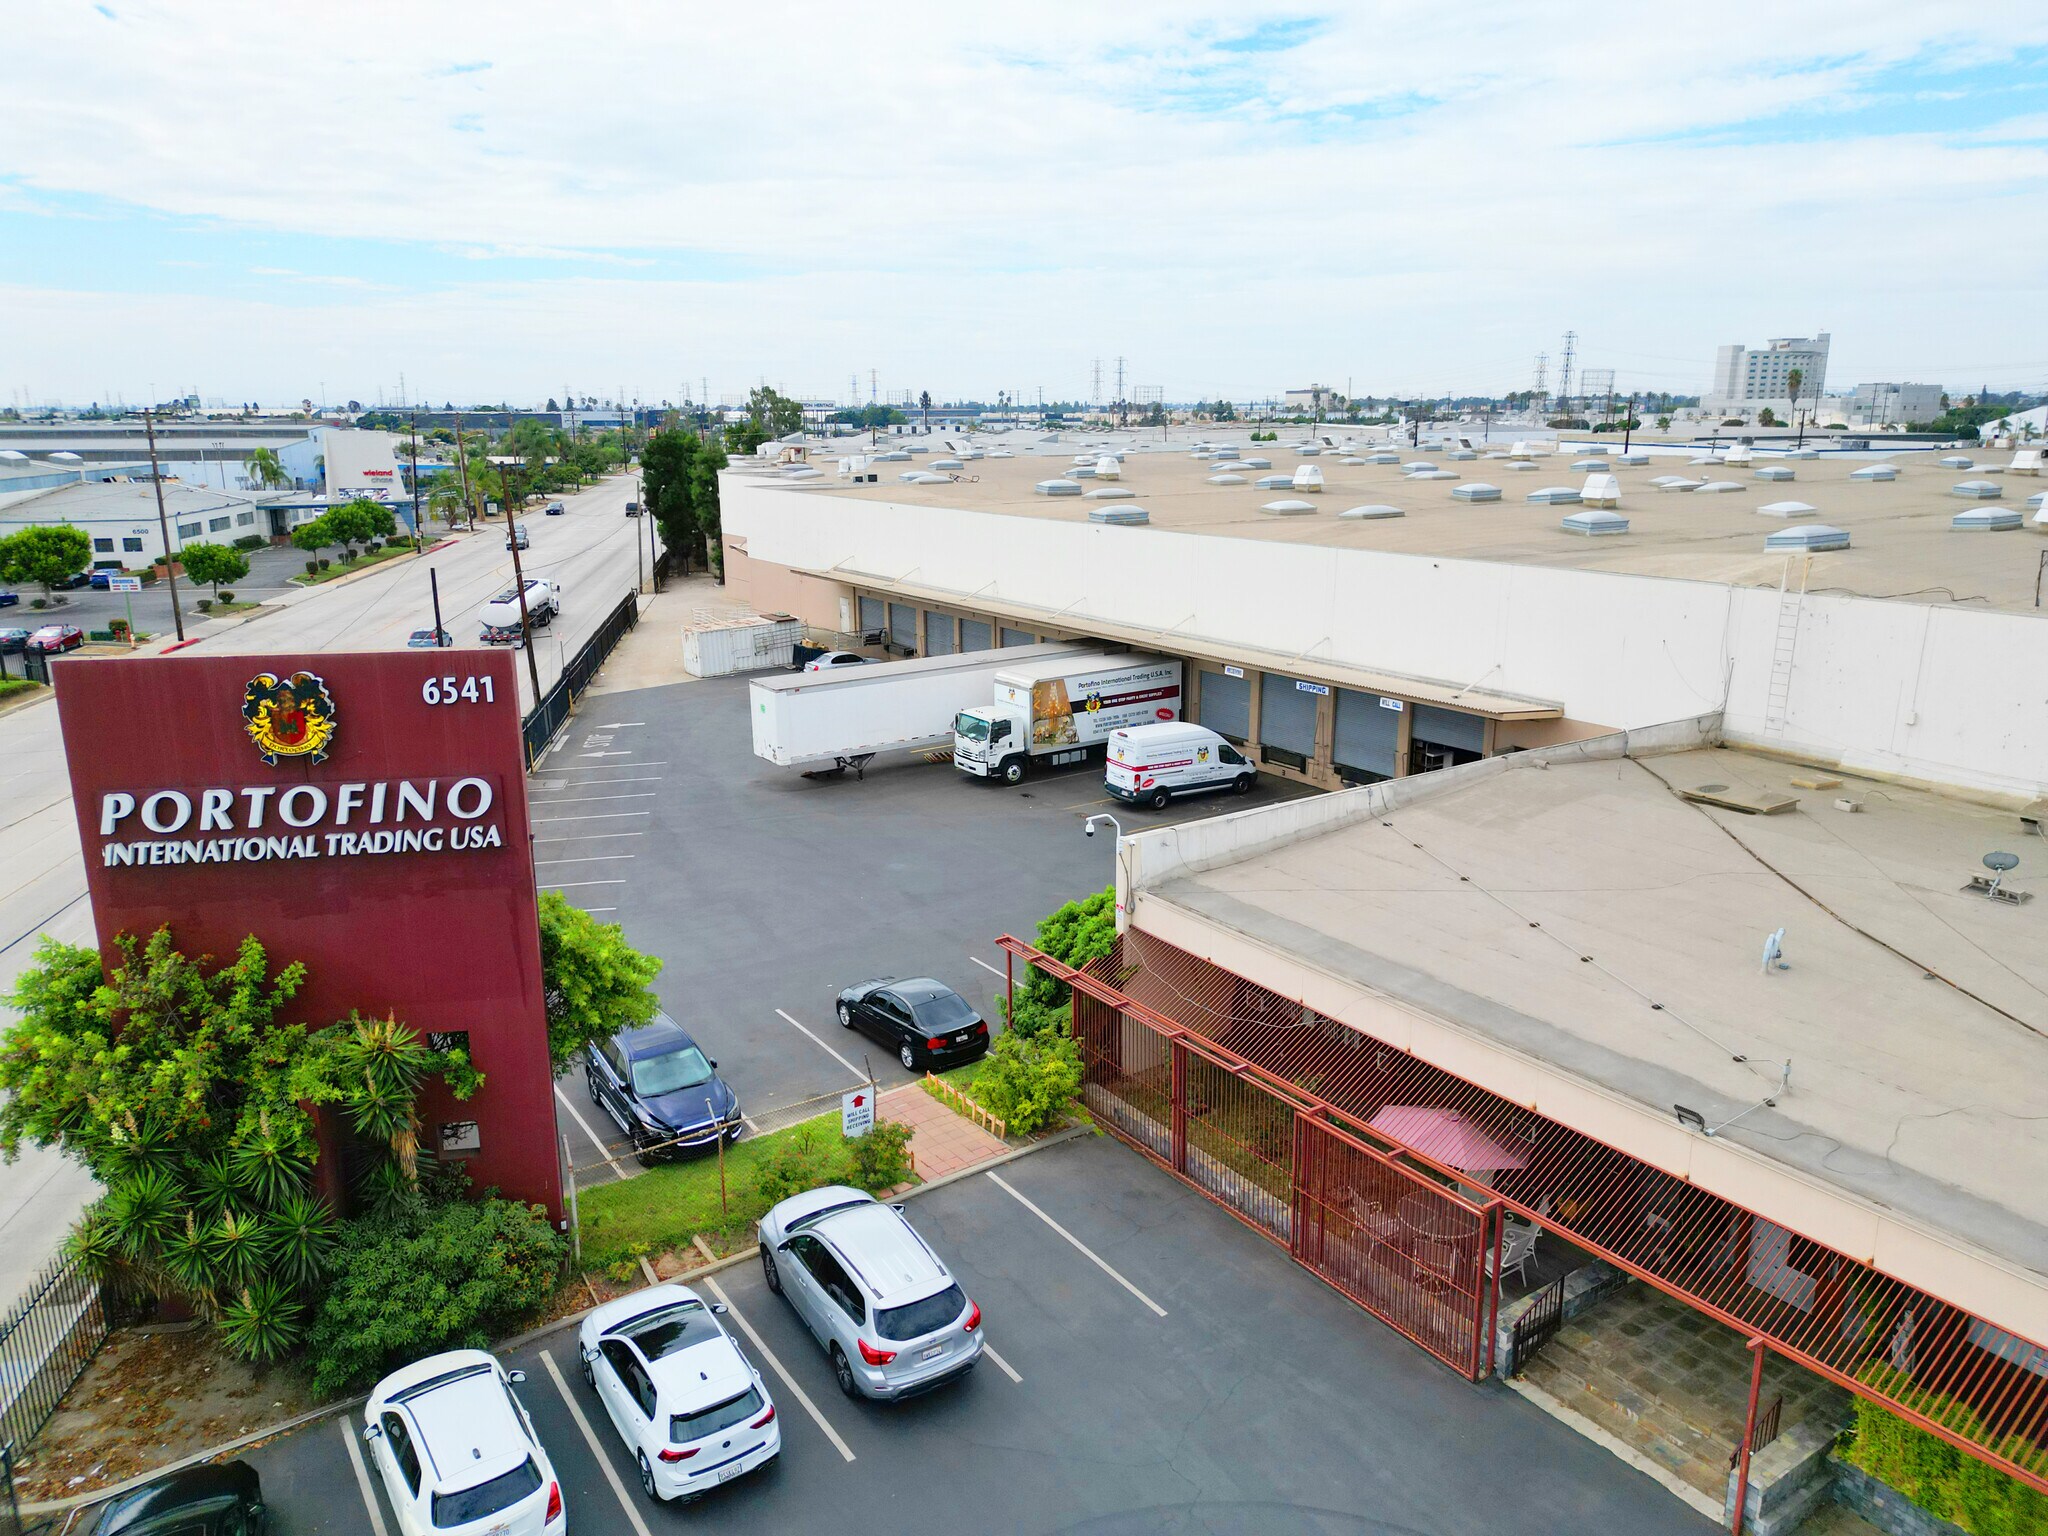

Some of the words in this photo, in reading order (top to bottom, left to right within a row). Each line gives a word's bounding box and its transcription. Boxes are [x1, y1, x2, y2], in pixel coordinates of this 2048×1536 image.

[1101, 676, 1132, 684] International
[422, 676, 494, 705] 6541
[1299, 683, 1326, 694] SHIPPING
[100, 777, 493, 835] PORTOFINO
[102, 834, 320, 866] INTERNATIONAL
[325, 828, 444, 856] TRADING
[450, 824, 502, 849] USA
[848, 1113, 870, 1124] SHIPPING
[846, 1119, 870, 1130] RECEIVING
